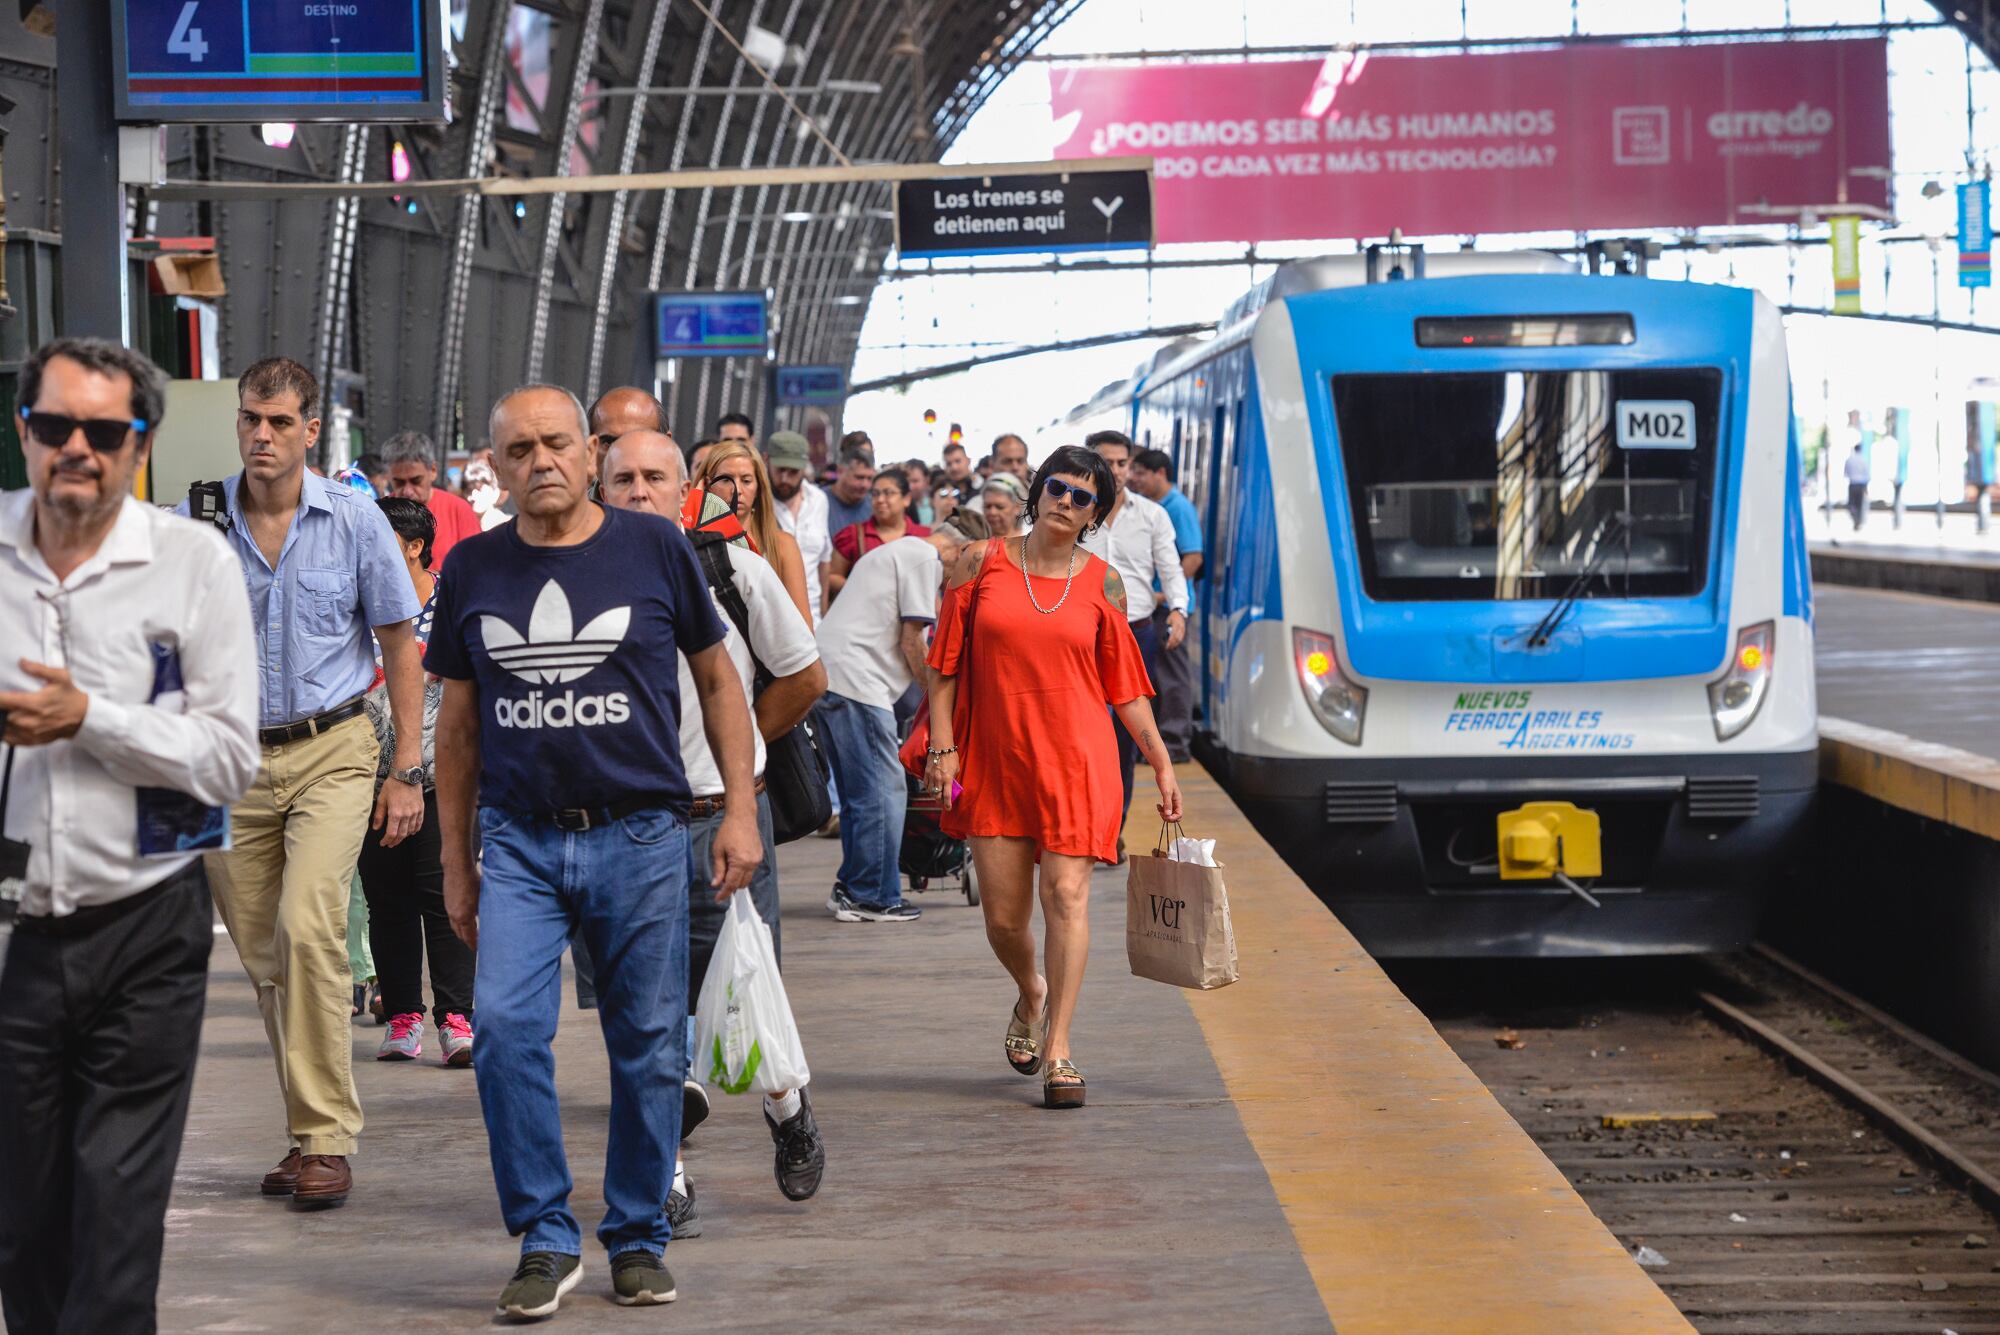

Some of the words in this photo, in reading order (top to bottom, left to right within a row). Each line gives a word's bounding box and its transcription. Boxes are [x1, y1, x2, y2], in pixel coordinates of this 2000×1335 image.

[304, 4, 358, 16] DESTINO
[166, 1, 209, 62] 4
[1090, 118, 1259, 154] ¿PODEMOS
[1264, 117, 1319, 144] SER
[1326, 108, 1392, 141] MÁS
[1399, 108, 1555, 139] HUMANOS
[1706, 100, 1833, 137] arredo
[1202, 154, 1271, 178] CADA
[1273, 152, 1321, 175] VEZ
[1326, 146, 1380, 174] MÁS
[1386, 141, 1557, 171] TECNOLOGÍA?
[933, 190, 969, 209] Los
[972, 189, 1037, 207] trenes
[1040, 188, 1064, 205] se
[933, 215, 1019, 235] detienen
[1022, 210, 1065, 234] aquí
[1629, 412, 1685, 437] M02
[494, 690, 631, 729] adidas
[1453, 690, 1532, 710] NUEVOS
[1498, 720, 1635, 749] ARGENTINOS
[1148, 894, 1186, 929] ver
